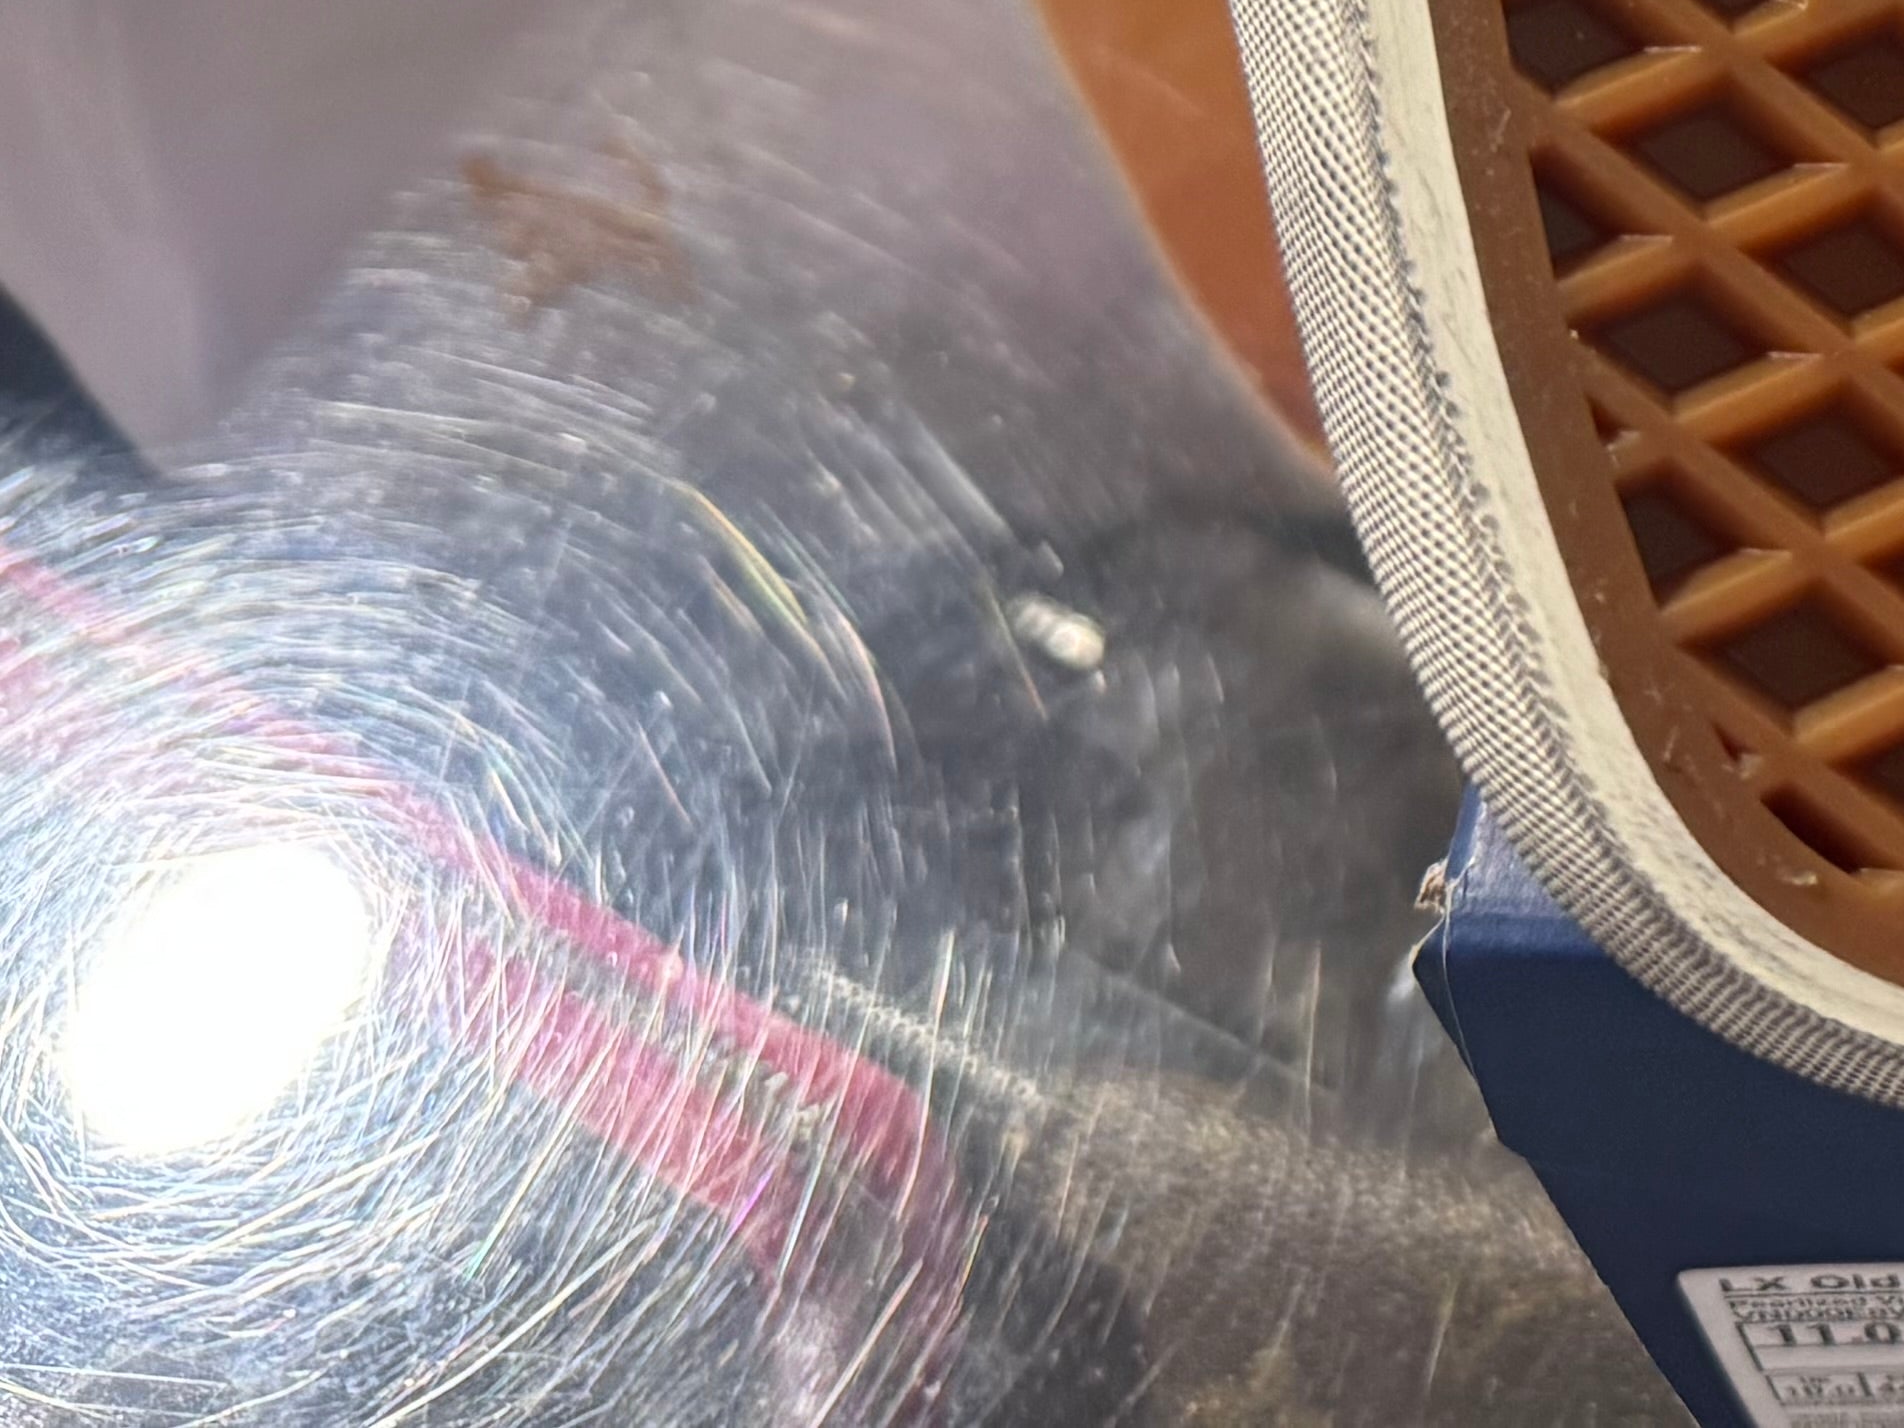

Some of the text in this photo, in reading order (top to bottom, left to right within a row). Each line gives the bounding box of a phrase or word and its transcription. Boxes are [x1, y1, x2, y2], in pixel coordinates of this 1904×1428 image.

[1720, 1275, 1787, 1292] LX
[1810, 1273, 1901, 1289] Old
[1767, 1321, 1901, 1347] 11.0
